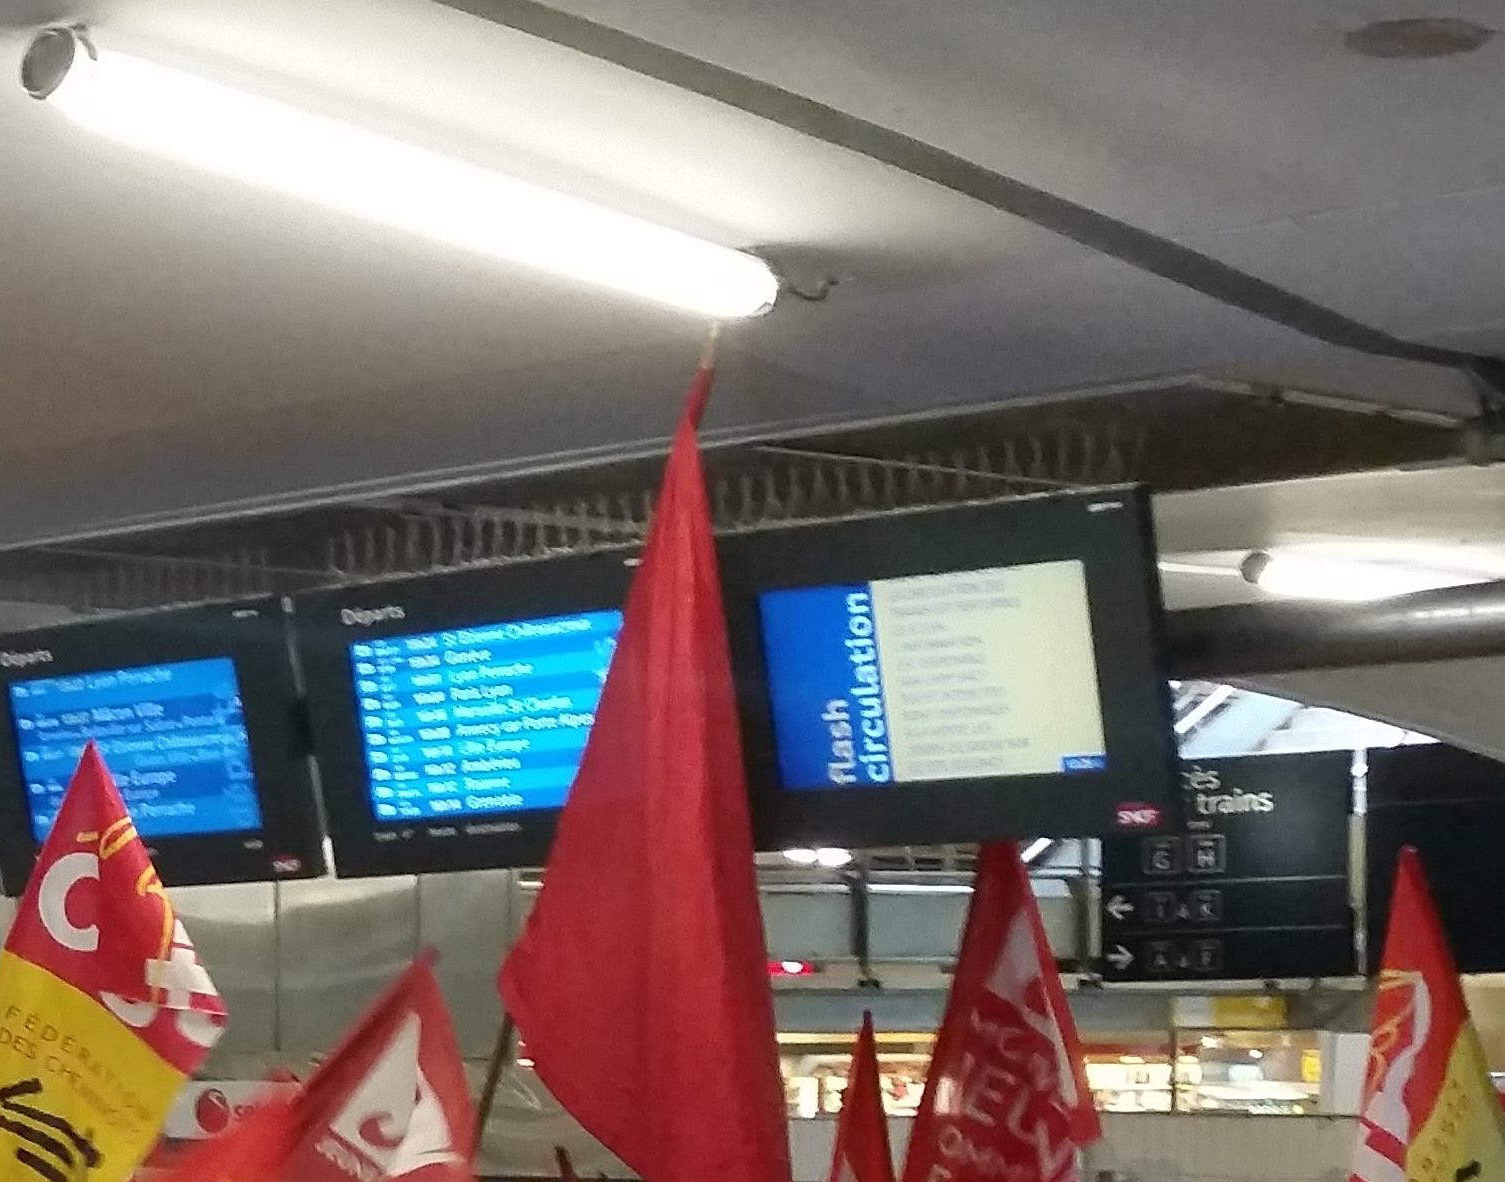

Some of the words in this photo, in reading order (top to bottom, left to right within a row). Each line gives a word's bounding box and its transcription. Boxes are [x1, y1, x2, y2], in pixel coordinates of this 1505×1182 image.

[821, 700, 857, 786] flash
[844, 591, 891, 784] circulation
[1196, 787, 1275, 815] trains
